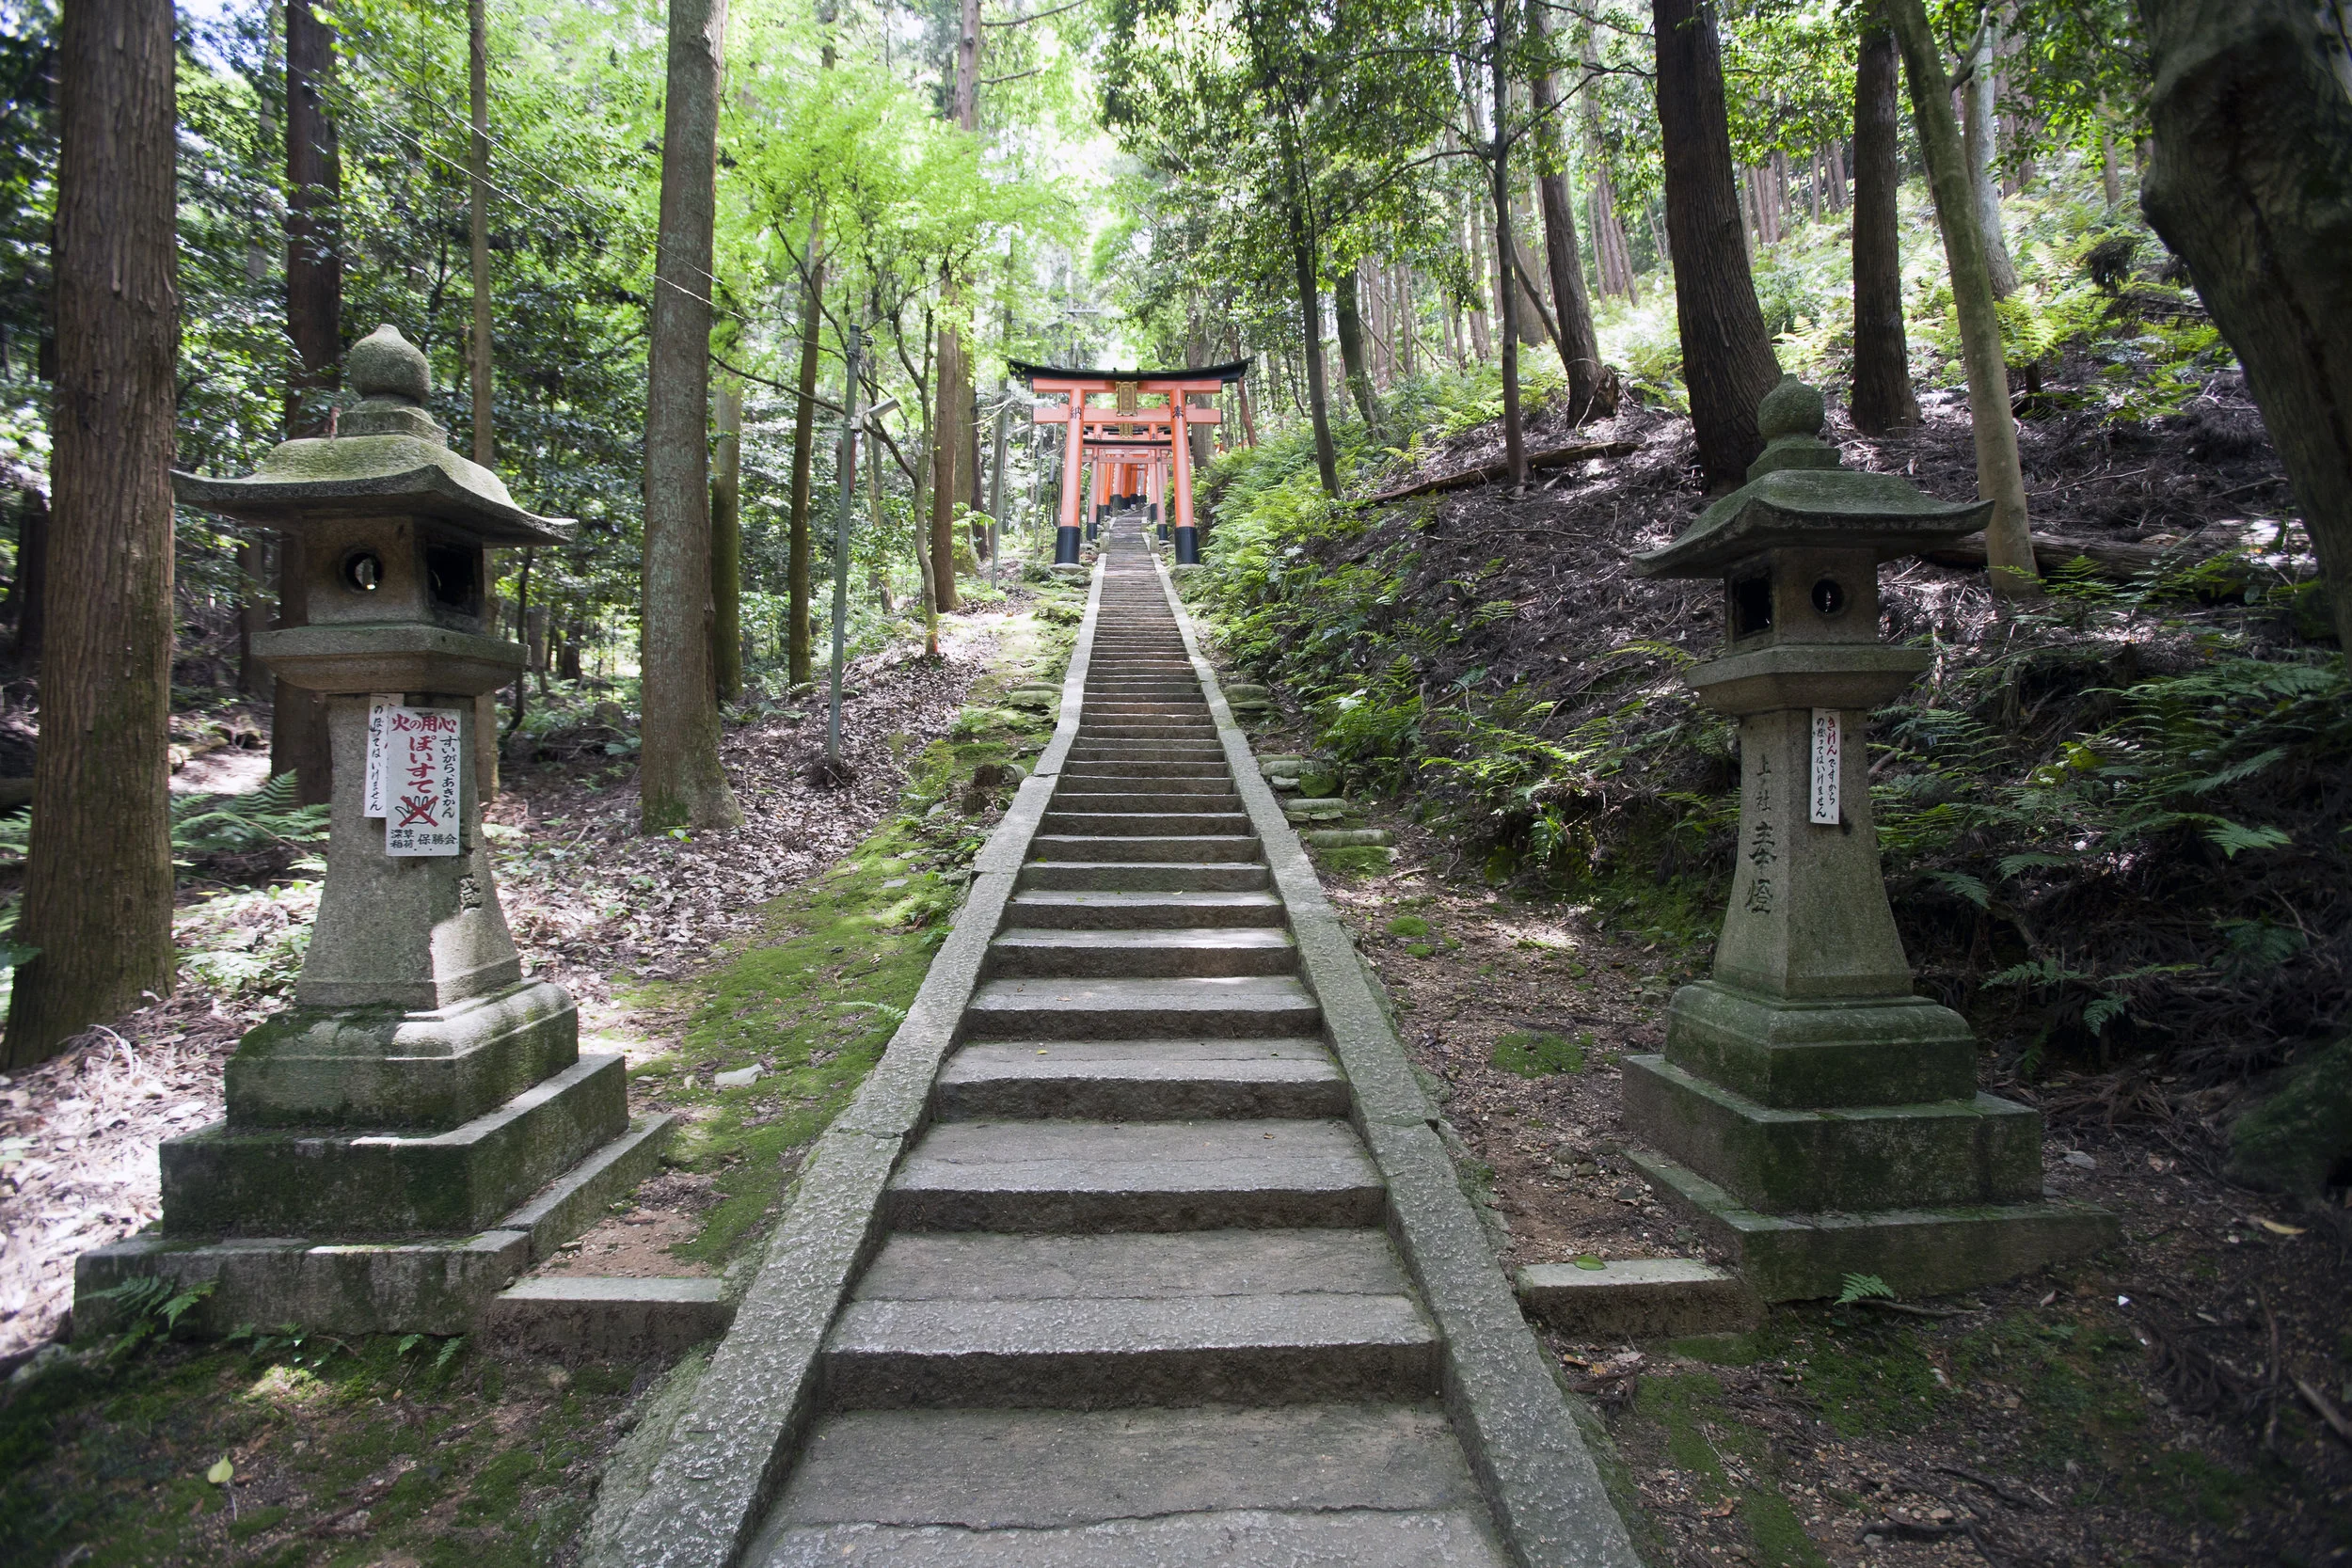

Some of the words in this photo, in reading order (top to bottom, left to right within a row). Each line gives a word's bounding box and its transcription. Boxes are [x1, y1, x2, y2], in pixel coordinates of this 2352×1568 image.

[391, 713, 457, 734] 火の用心
[405, 735, 437, 794] ぽいすて
[439, 735, 458, 819] すいがら、あきかん
[1825, 715, 1837, 806] きけんですから
